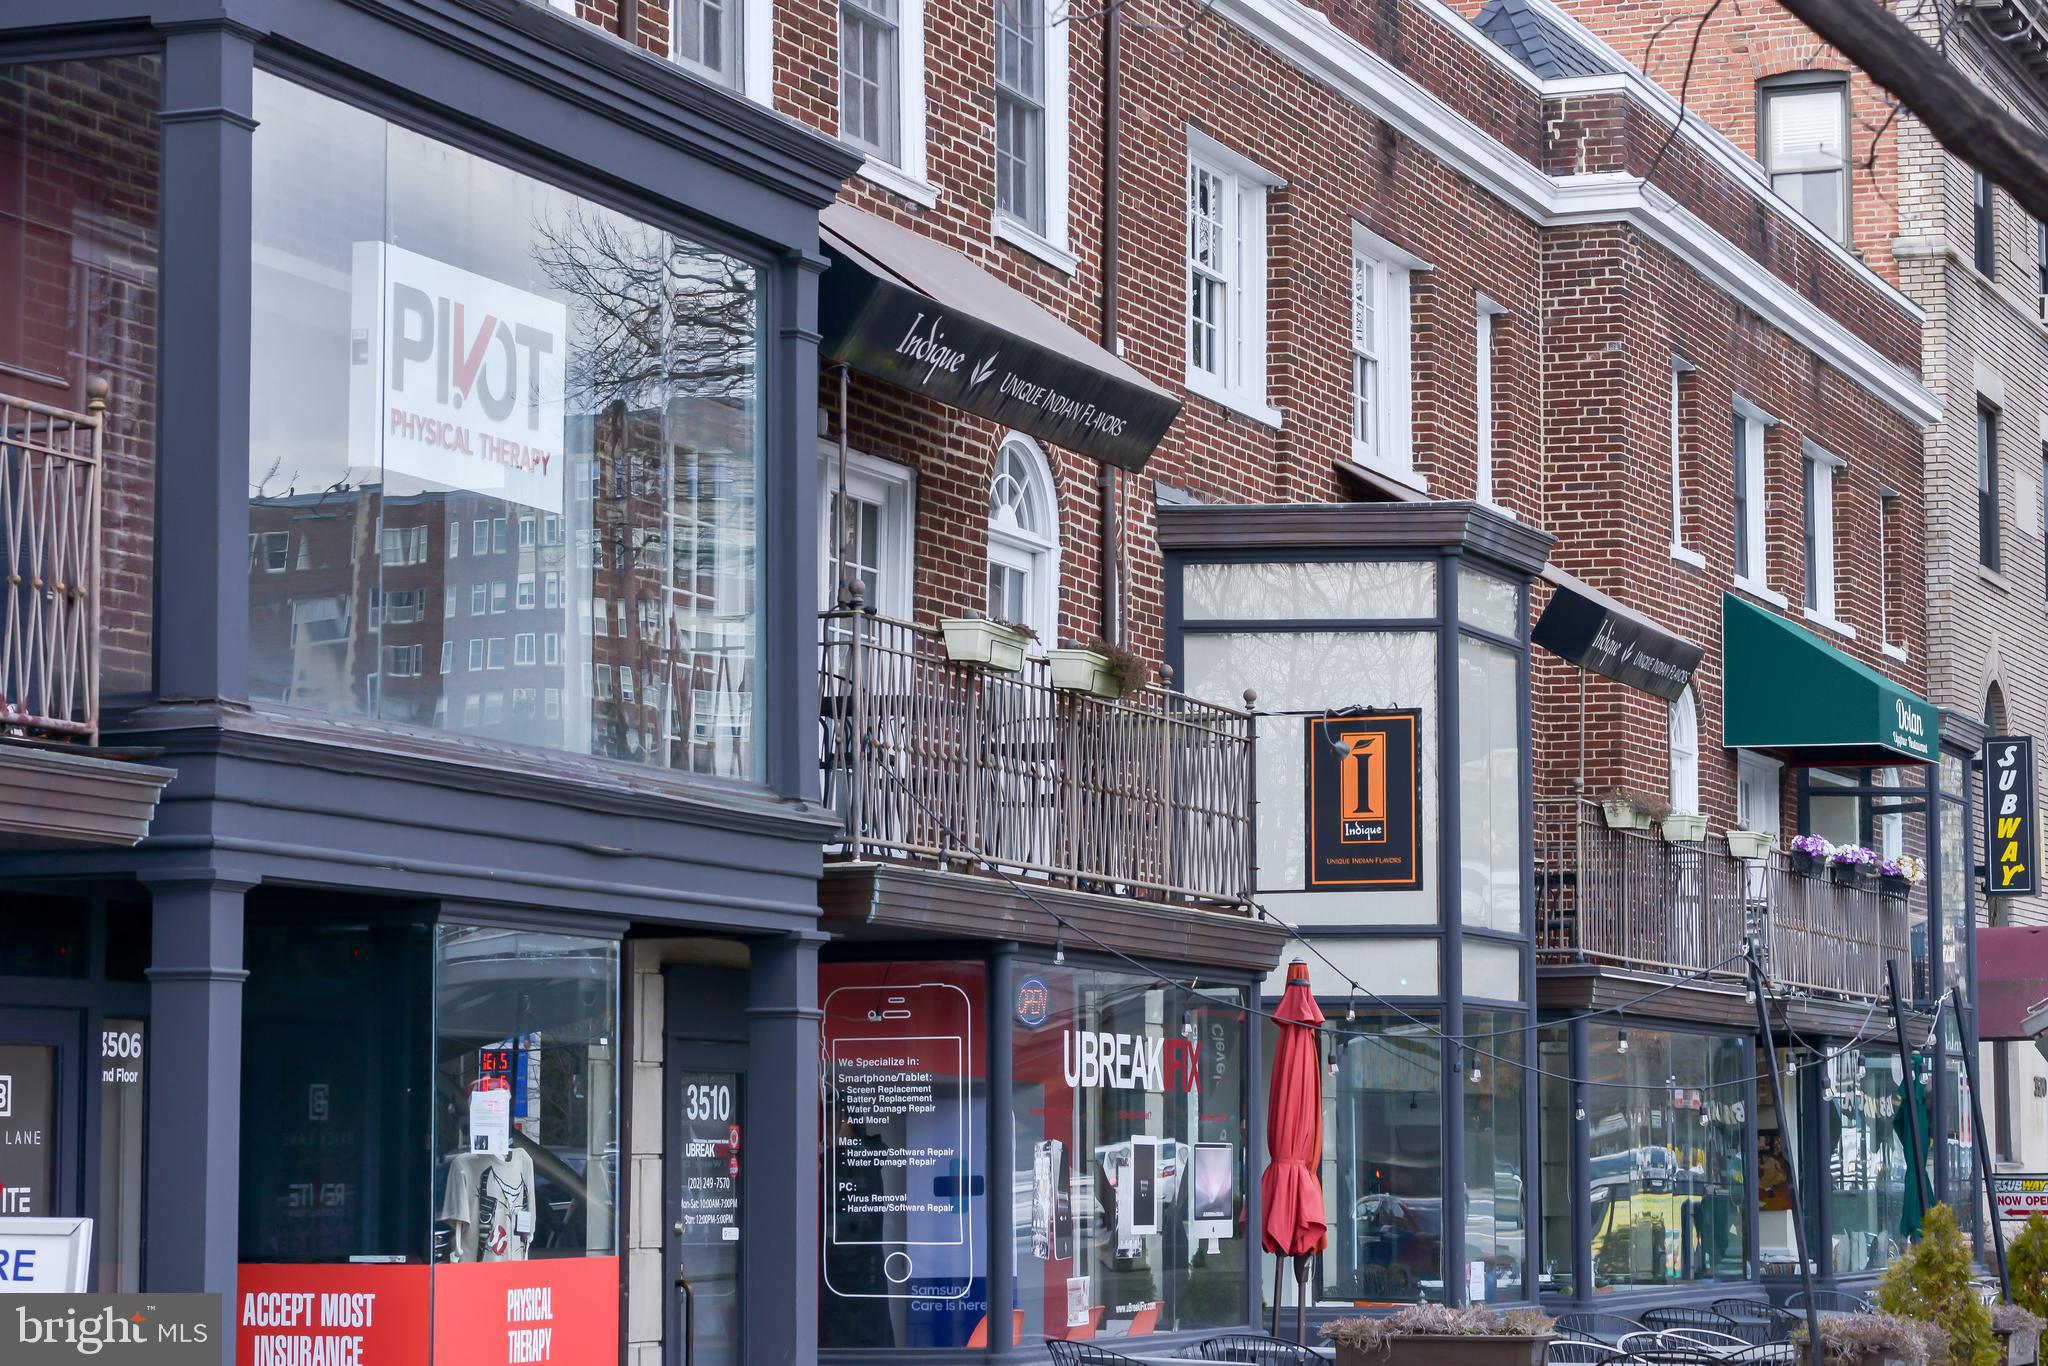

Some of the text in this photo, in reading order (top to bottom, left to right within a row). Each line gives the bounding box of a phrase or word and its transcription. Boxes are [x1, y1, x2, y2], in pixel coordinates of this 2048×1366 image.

[391, 281, 553, 431] PIVOT
[896, 313, 965, 385] Indique
[1000, 372, 1127, 437] UNIQUE INDIAN FLAVORS
[390, 407, 551, 476] PHYSICAL THERAPY
[1592, 619, 1622, 667] Indique
[1896, 698, 1924, 737] Dolan
[1997, 745, 2025, 886] SUBWAY
[1345, 822, 1382, 840] Indique
[1326, 856, 1402, 866] UNIQUE INDIAN FLAVORS
[1018, 989, 1048, 1015] OPEN
[838, 1057, 920, 1069] We Specialize in:
[1063, 1030, 1204, 1094] UBREAKIFIX
[102, 1067, 138, 1083] nd Floor
[838, 1072, 932, 1084] Smartphone/Tablet:
[846, 1085, 931, 1095] Screen Replacement
[687, 1083, 730, 1122] 3510
[847, 1094, 933, 1105] Battery Replacement
[847, 1104, 936, 1115] Water Damage Repair
[847, 1115, 890, 1124] And More!
[5, 1130, 41, 1145] LANE
[838, 1137, 862, 1146] Mac:
[847, 1147, 954, 1158] Hardware/Software Repair
[847, 1157, 936, 1168] Water Damage Repair
[688, 1177, 702, 1191] (202)
[703, 1177, 713, 1189] 249
[838, 1182, 857, 1192] PC:
[1997, 1180, 2048, 1192] SUBWAY
[847, 1193, 907, 1203] Virus Removal
[1998, 1196, 2048, 1206] NOW OPE
[847, 1203, 954, 1213] Hardware/Software Repair
[911, 1285, 970, 1299] Samsung
[243, 1293, 375, 1328] ACCEPT MOST
[507, 1287, 553, 1323] PHYSICAL
[911, 1299, 987, 1311] Care is here
[254, 1334, 363, 1366] INSURANCE
[507, 1328, 552, 1364] THERAPY
